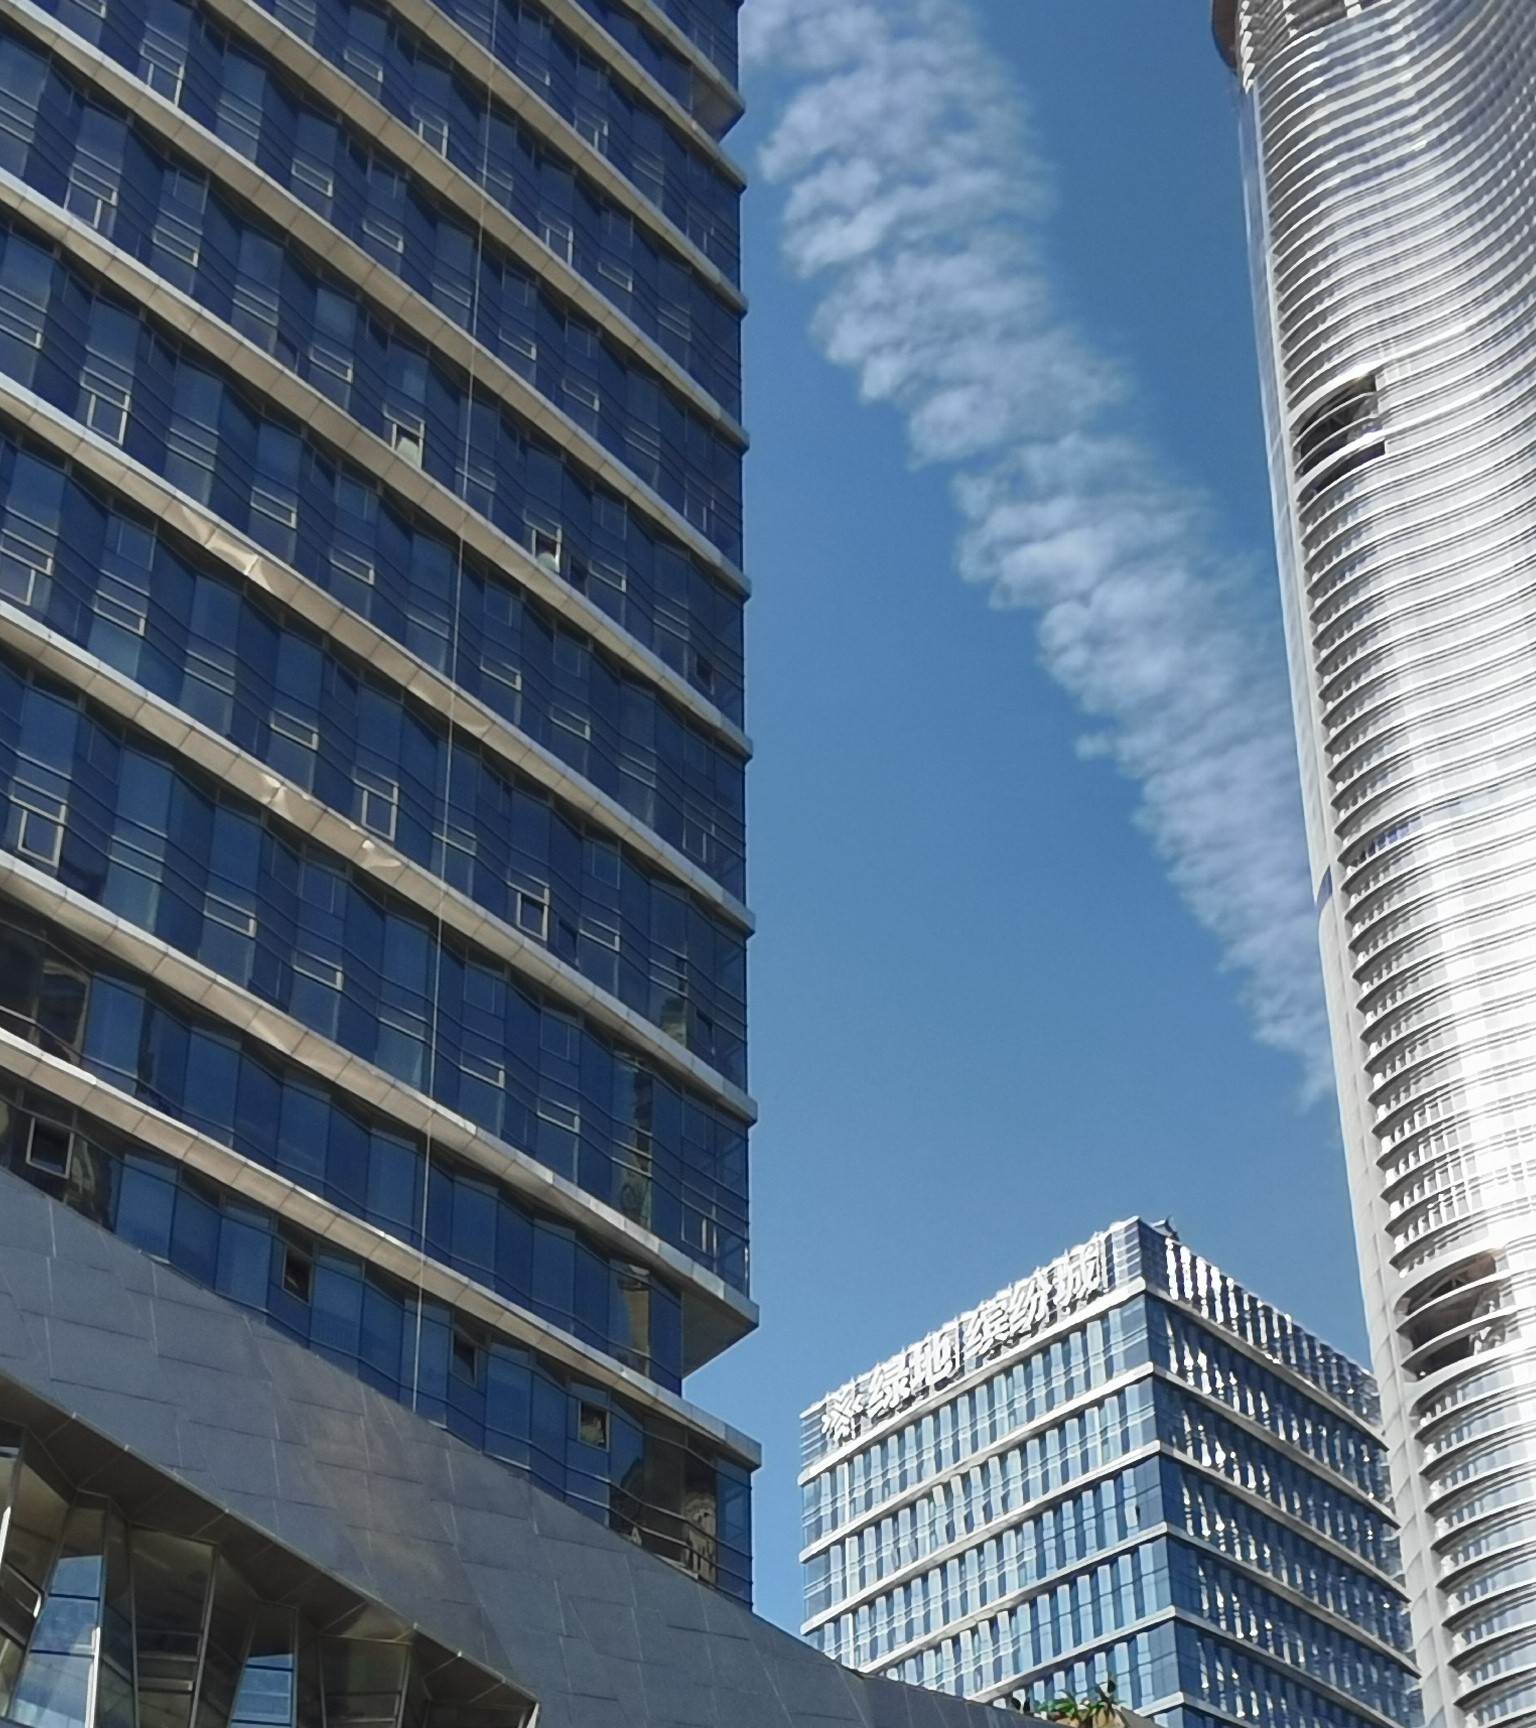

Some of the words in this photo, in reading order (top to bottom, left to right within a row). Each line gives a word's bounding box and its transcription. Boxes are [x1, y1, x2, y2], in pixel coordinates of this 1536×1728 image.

[866, 1240, 1102, 1419] 绿地缤纷城
